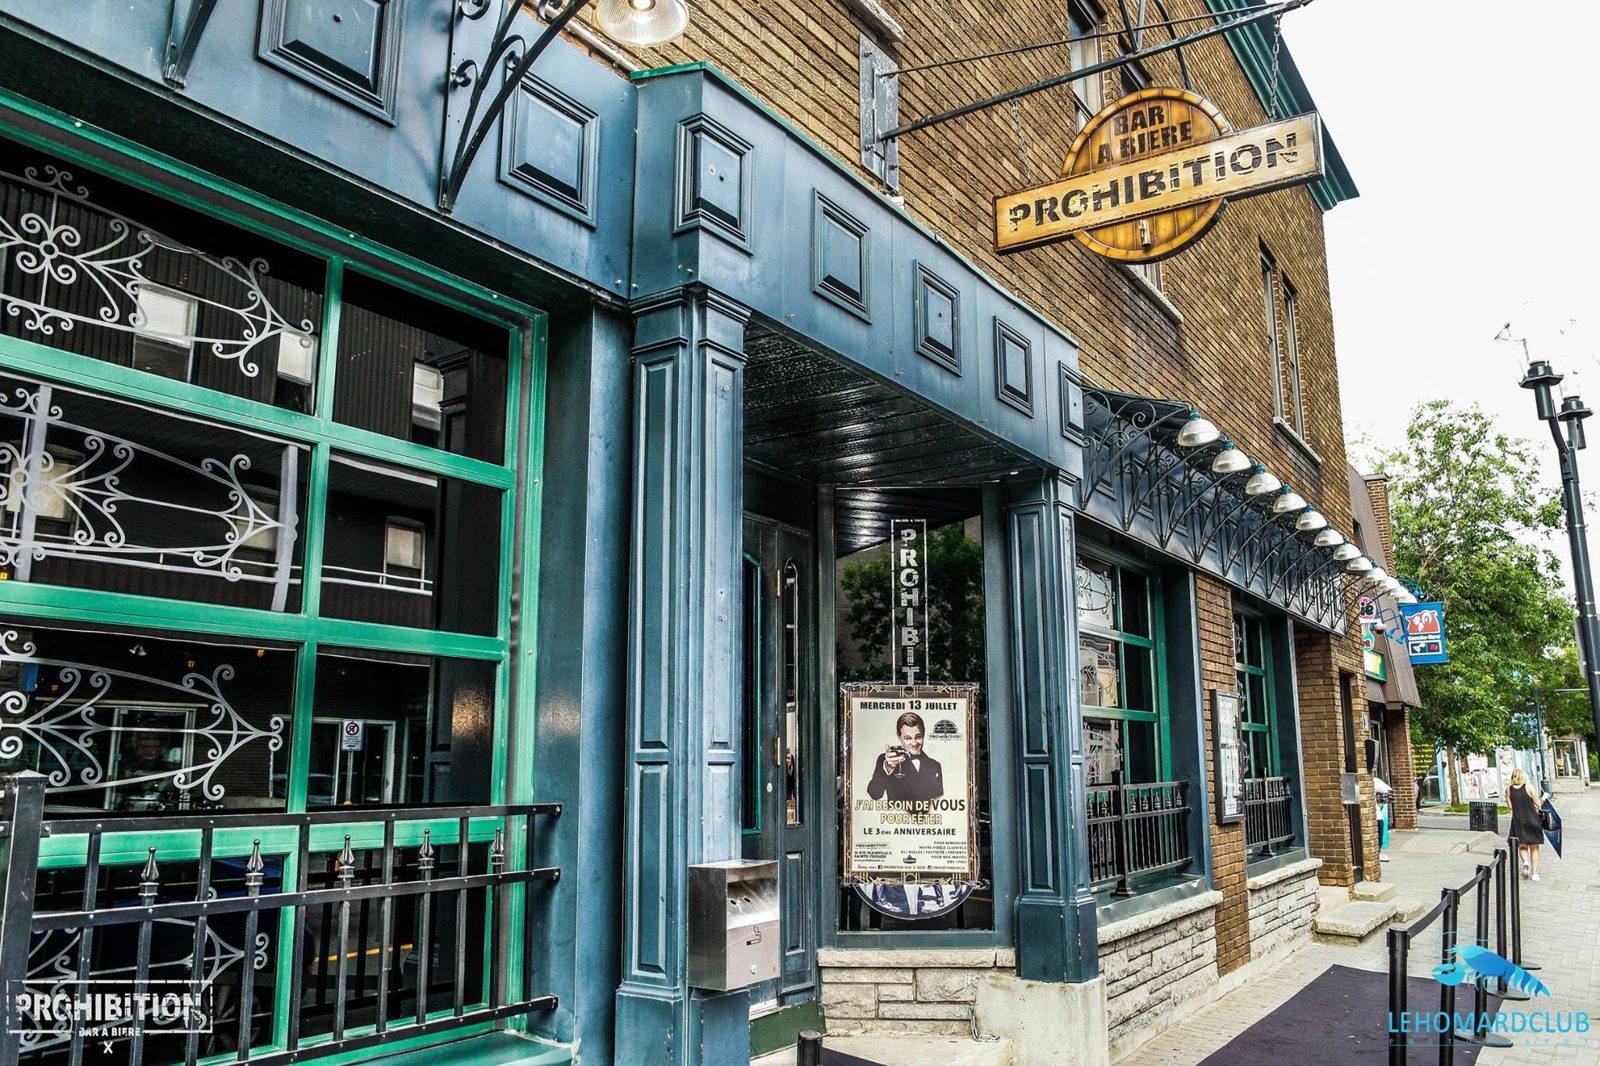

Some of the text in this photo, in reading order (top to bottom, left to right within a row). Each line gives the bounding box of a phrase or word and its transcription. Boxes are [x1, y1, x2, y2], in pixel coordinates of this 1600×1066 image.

[1113, 105, 1165, 136] BAR
[1008, 132, 1299, 234] PROHIBITION
[860, 700, 957, 711] MERCREDI 13 JUILLET
[875, 800, 913, 811] BESOIN
[916, 801, 929, 811] DE
[931, 799, 965, 811] VOUS
[880, 812, 942, 825] POUR FÊTER
[893, 828, 956, 836] ANNIVERSAIRE
